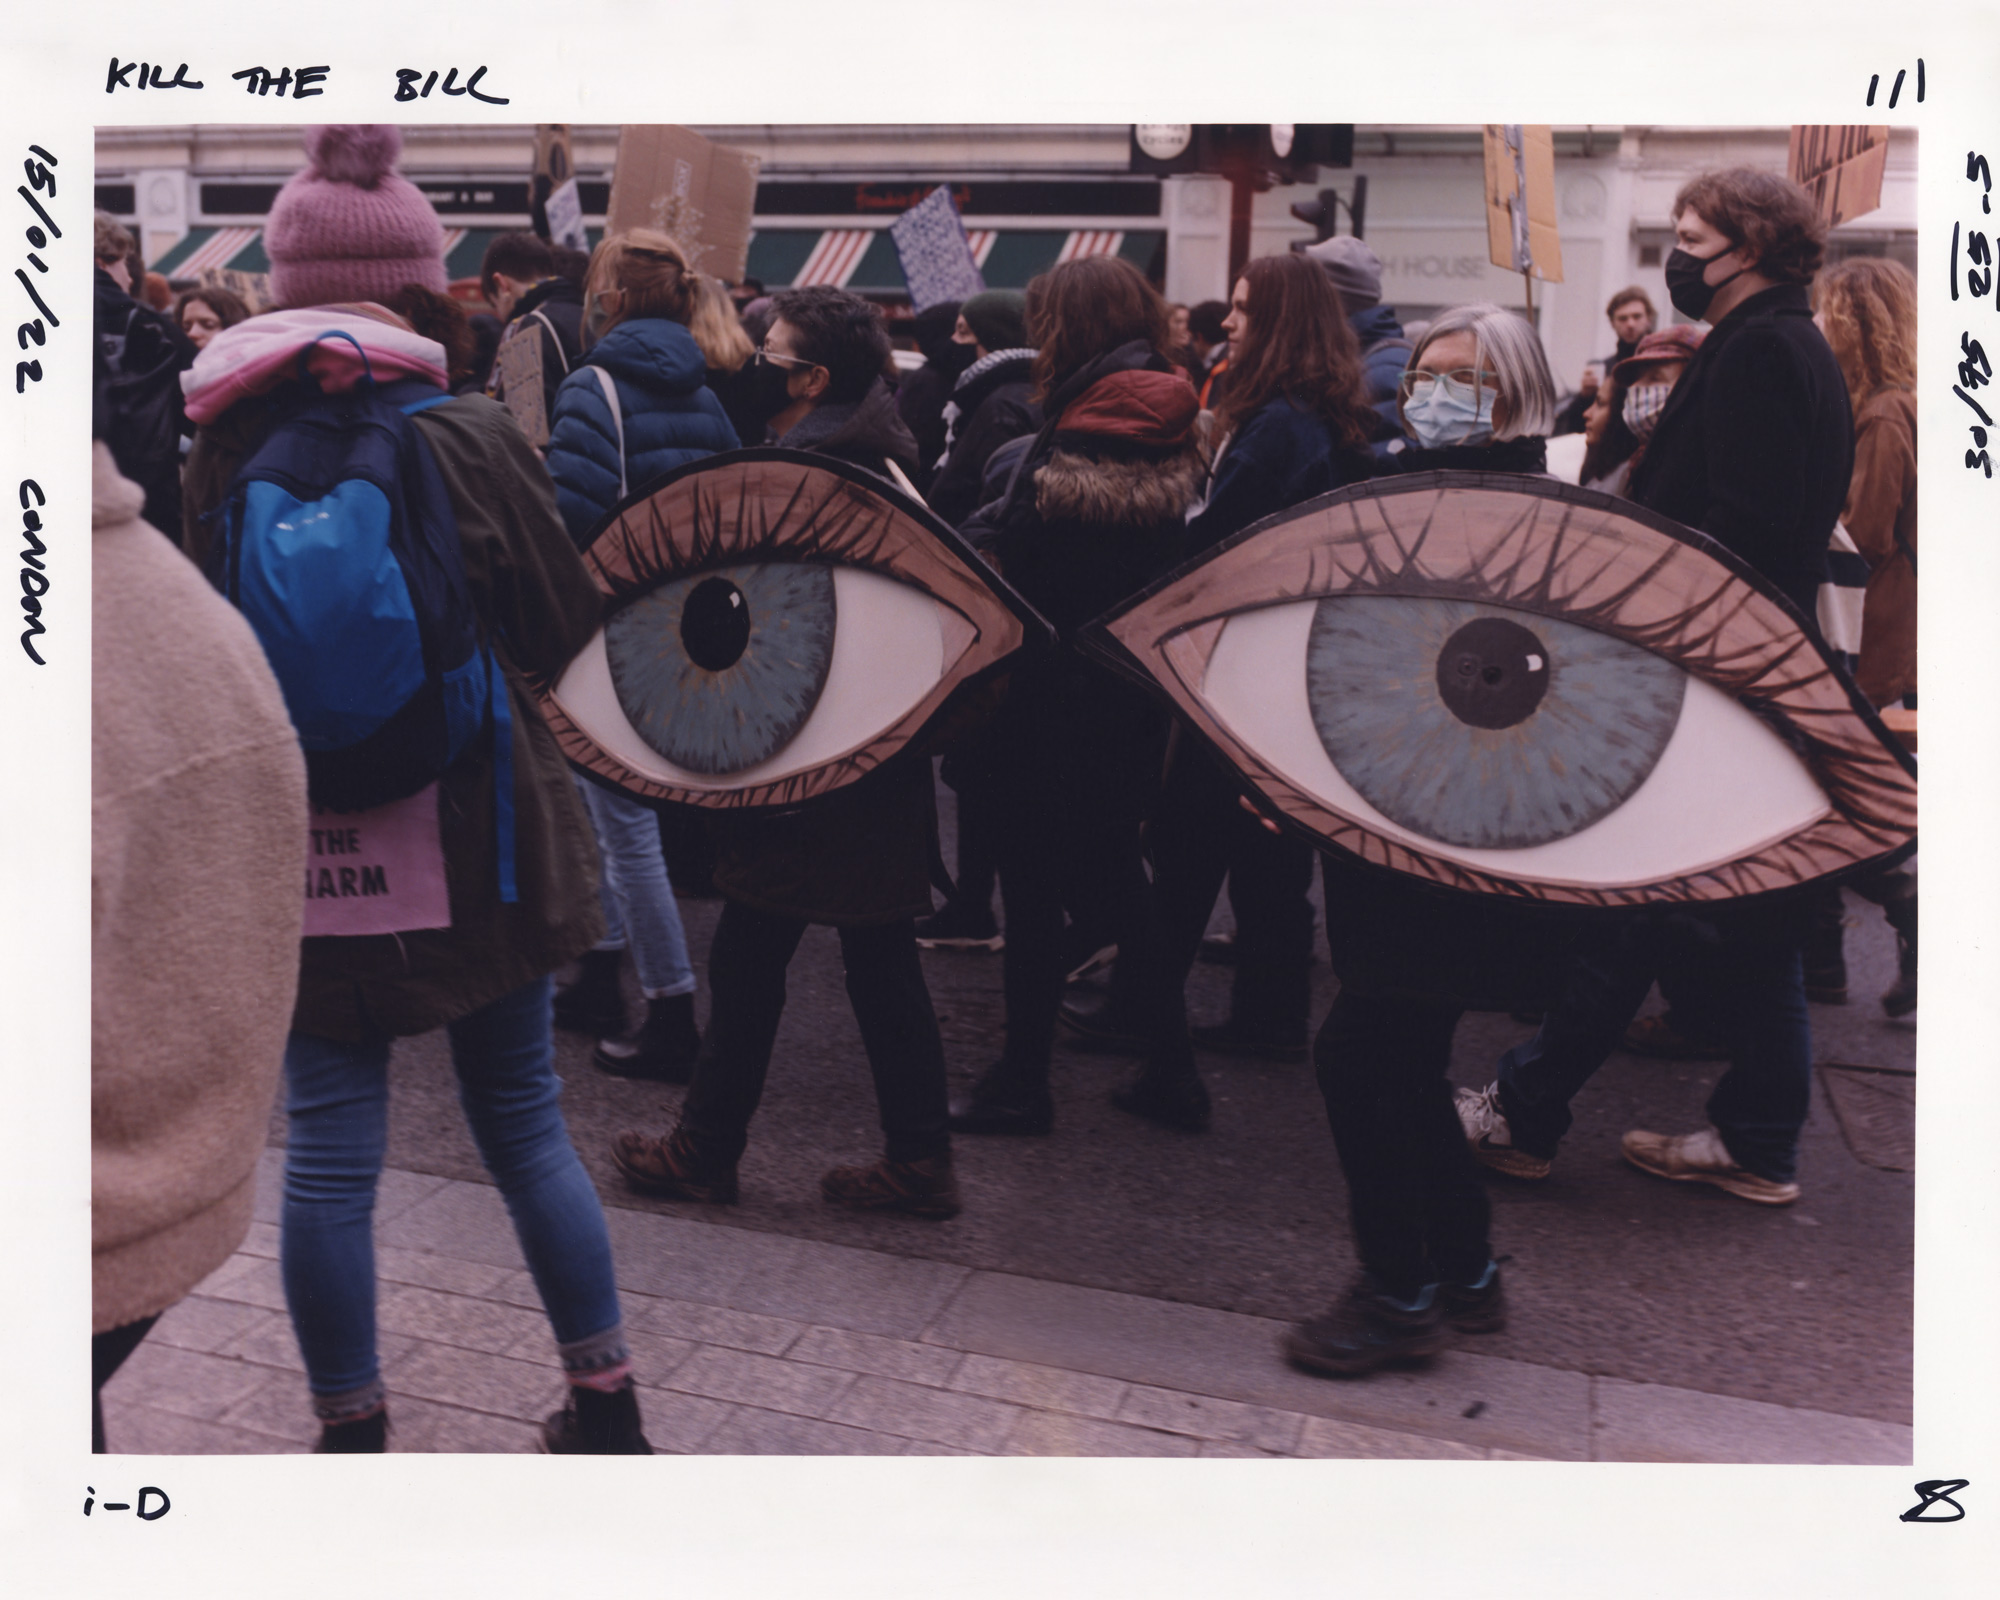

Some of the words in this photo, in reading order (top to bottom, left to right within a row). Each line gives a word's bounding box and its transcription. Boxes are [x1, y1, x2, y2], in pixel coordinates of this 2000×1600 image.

[105, 57, 204, 94] KILL
[231, 65, 331, 100] THE
[394, 65, 510, 105] BILL
[14, 144, 62, 394] 15/01/22
[1403, 255, 1485, 279] HOUSE
[311, 828, 361, 855] THE
[83, 1486, 171, 1521] i-D
